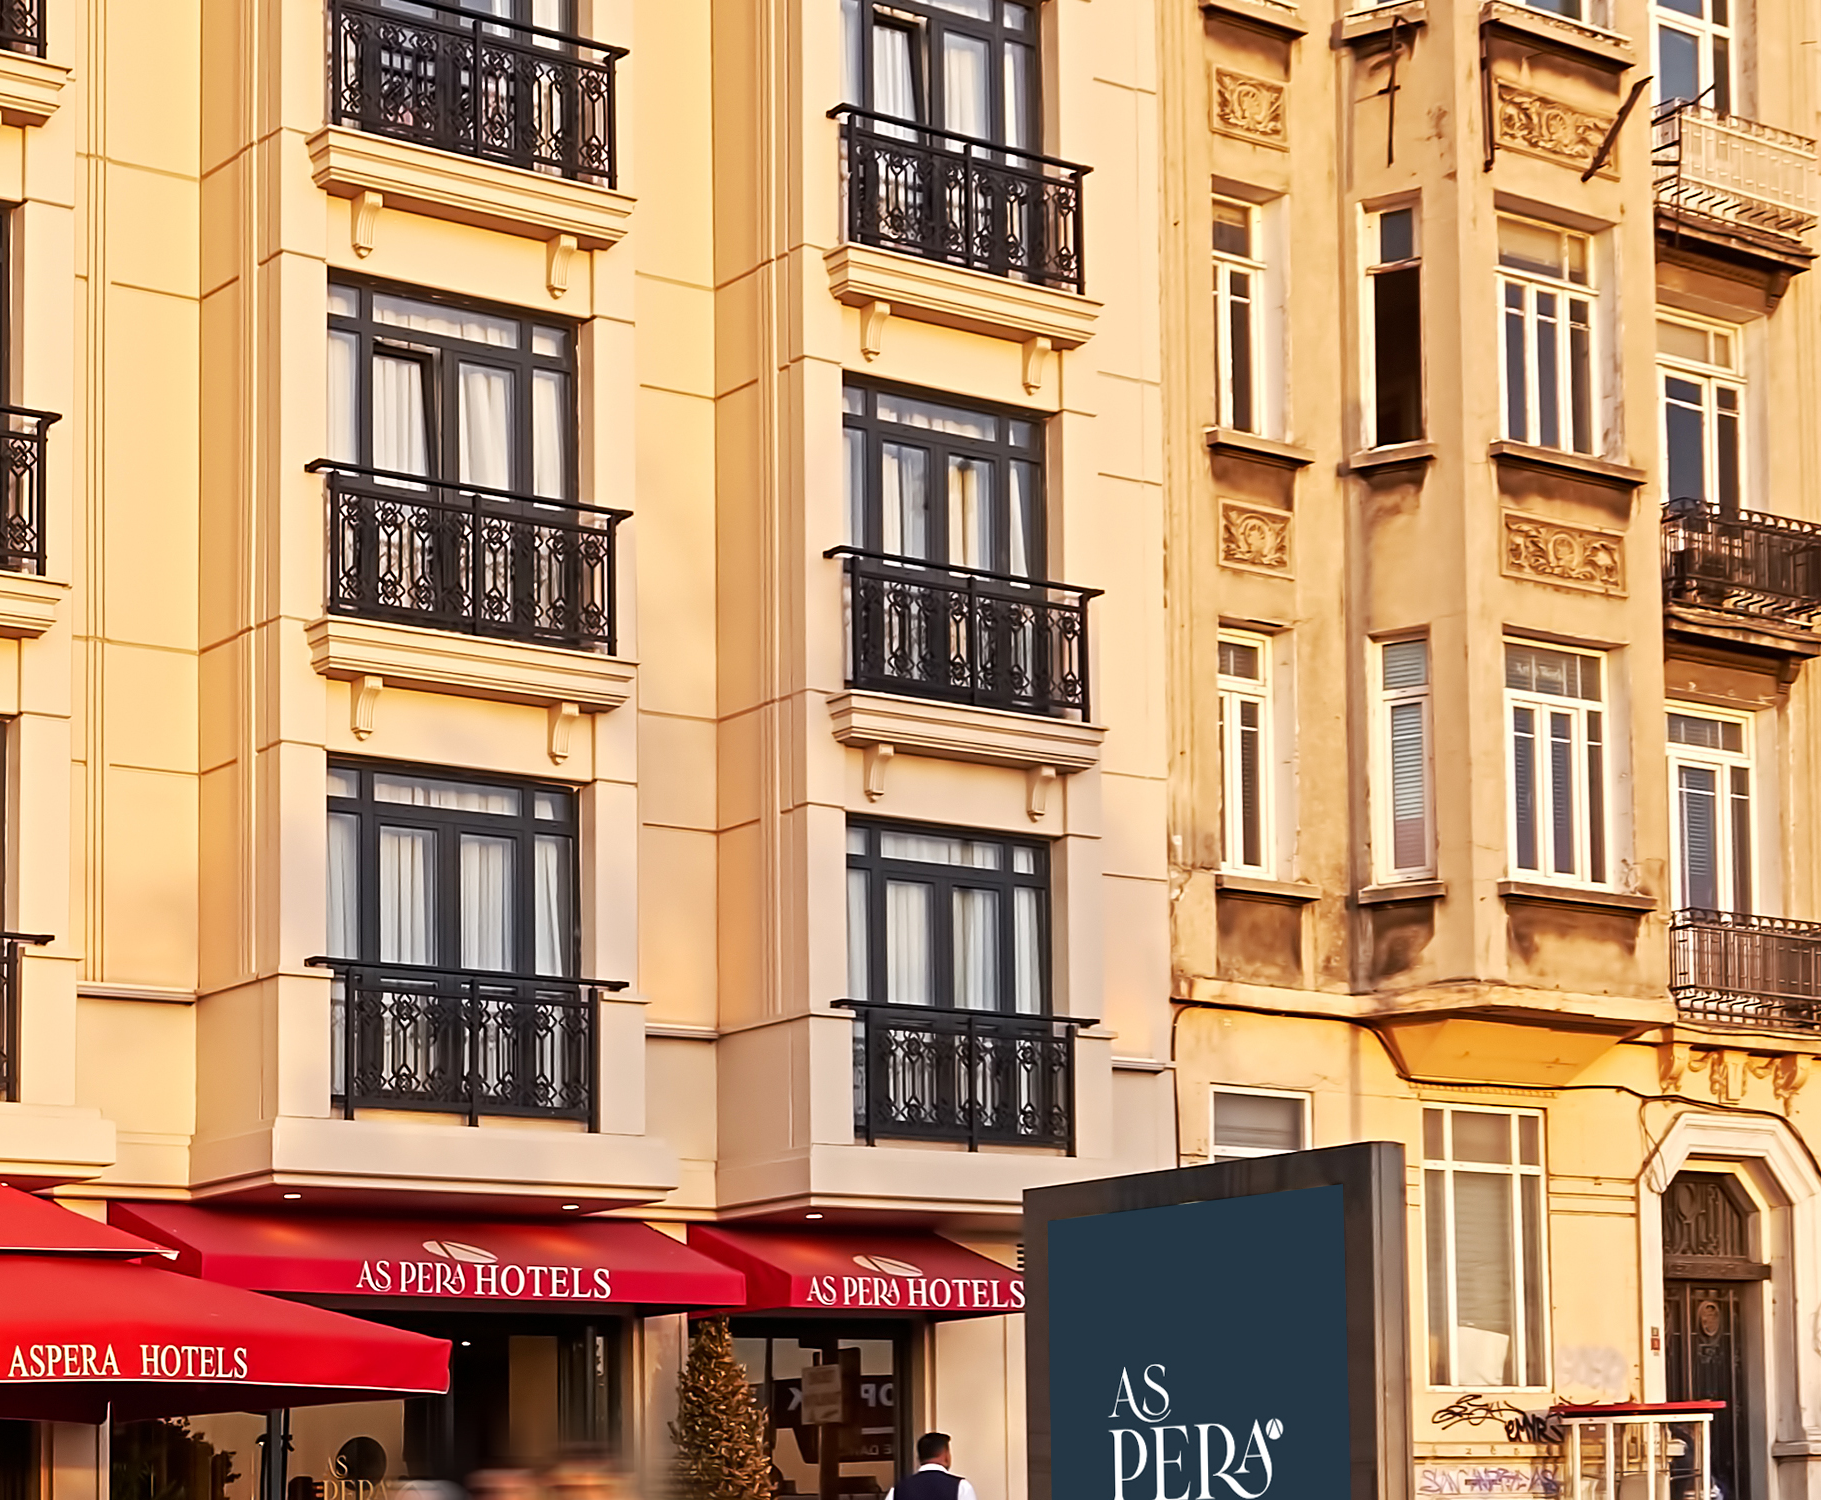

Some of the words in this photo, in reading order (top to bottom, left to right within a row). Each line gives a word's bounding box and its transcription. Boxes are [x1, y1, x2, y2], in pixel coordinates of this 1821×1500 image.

[356, 1260, 392, 1292] AS
[399, 1261, 466, 1295] PERA
[474, 1264, 612, 1299] HOTELS
[806, 1275, 837, 1305] AS
[842, 1276, 901, 1307] PERA
[906, 1278, 1026, 1309] HOTELS
[8, 1343, 122, 1378] ASPERA
[139, 1344, 248, 1379] HOTELS
[1108, 1363, 1172, 1423] AS
